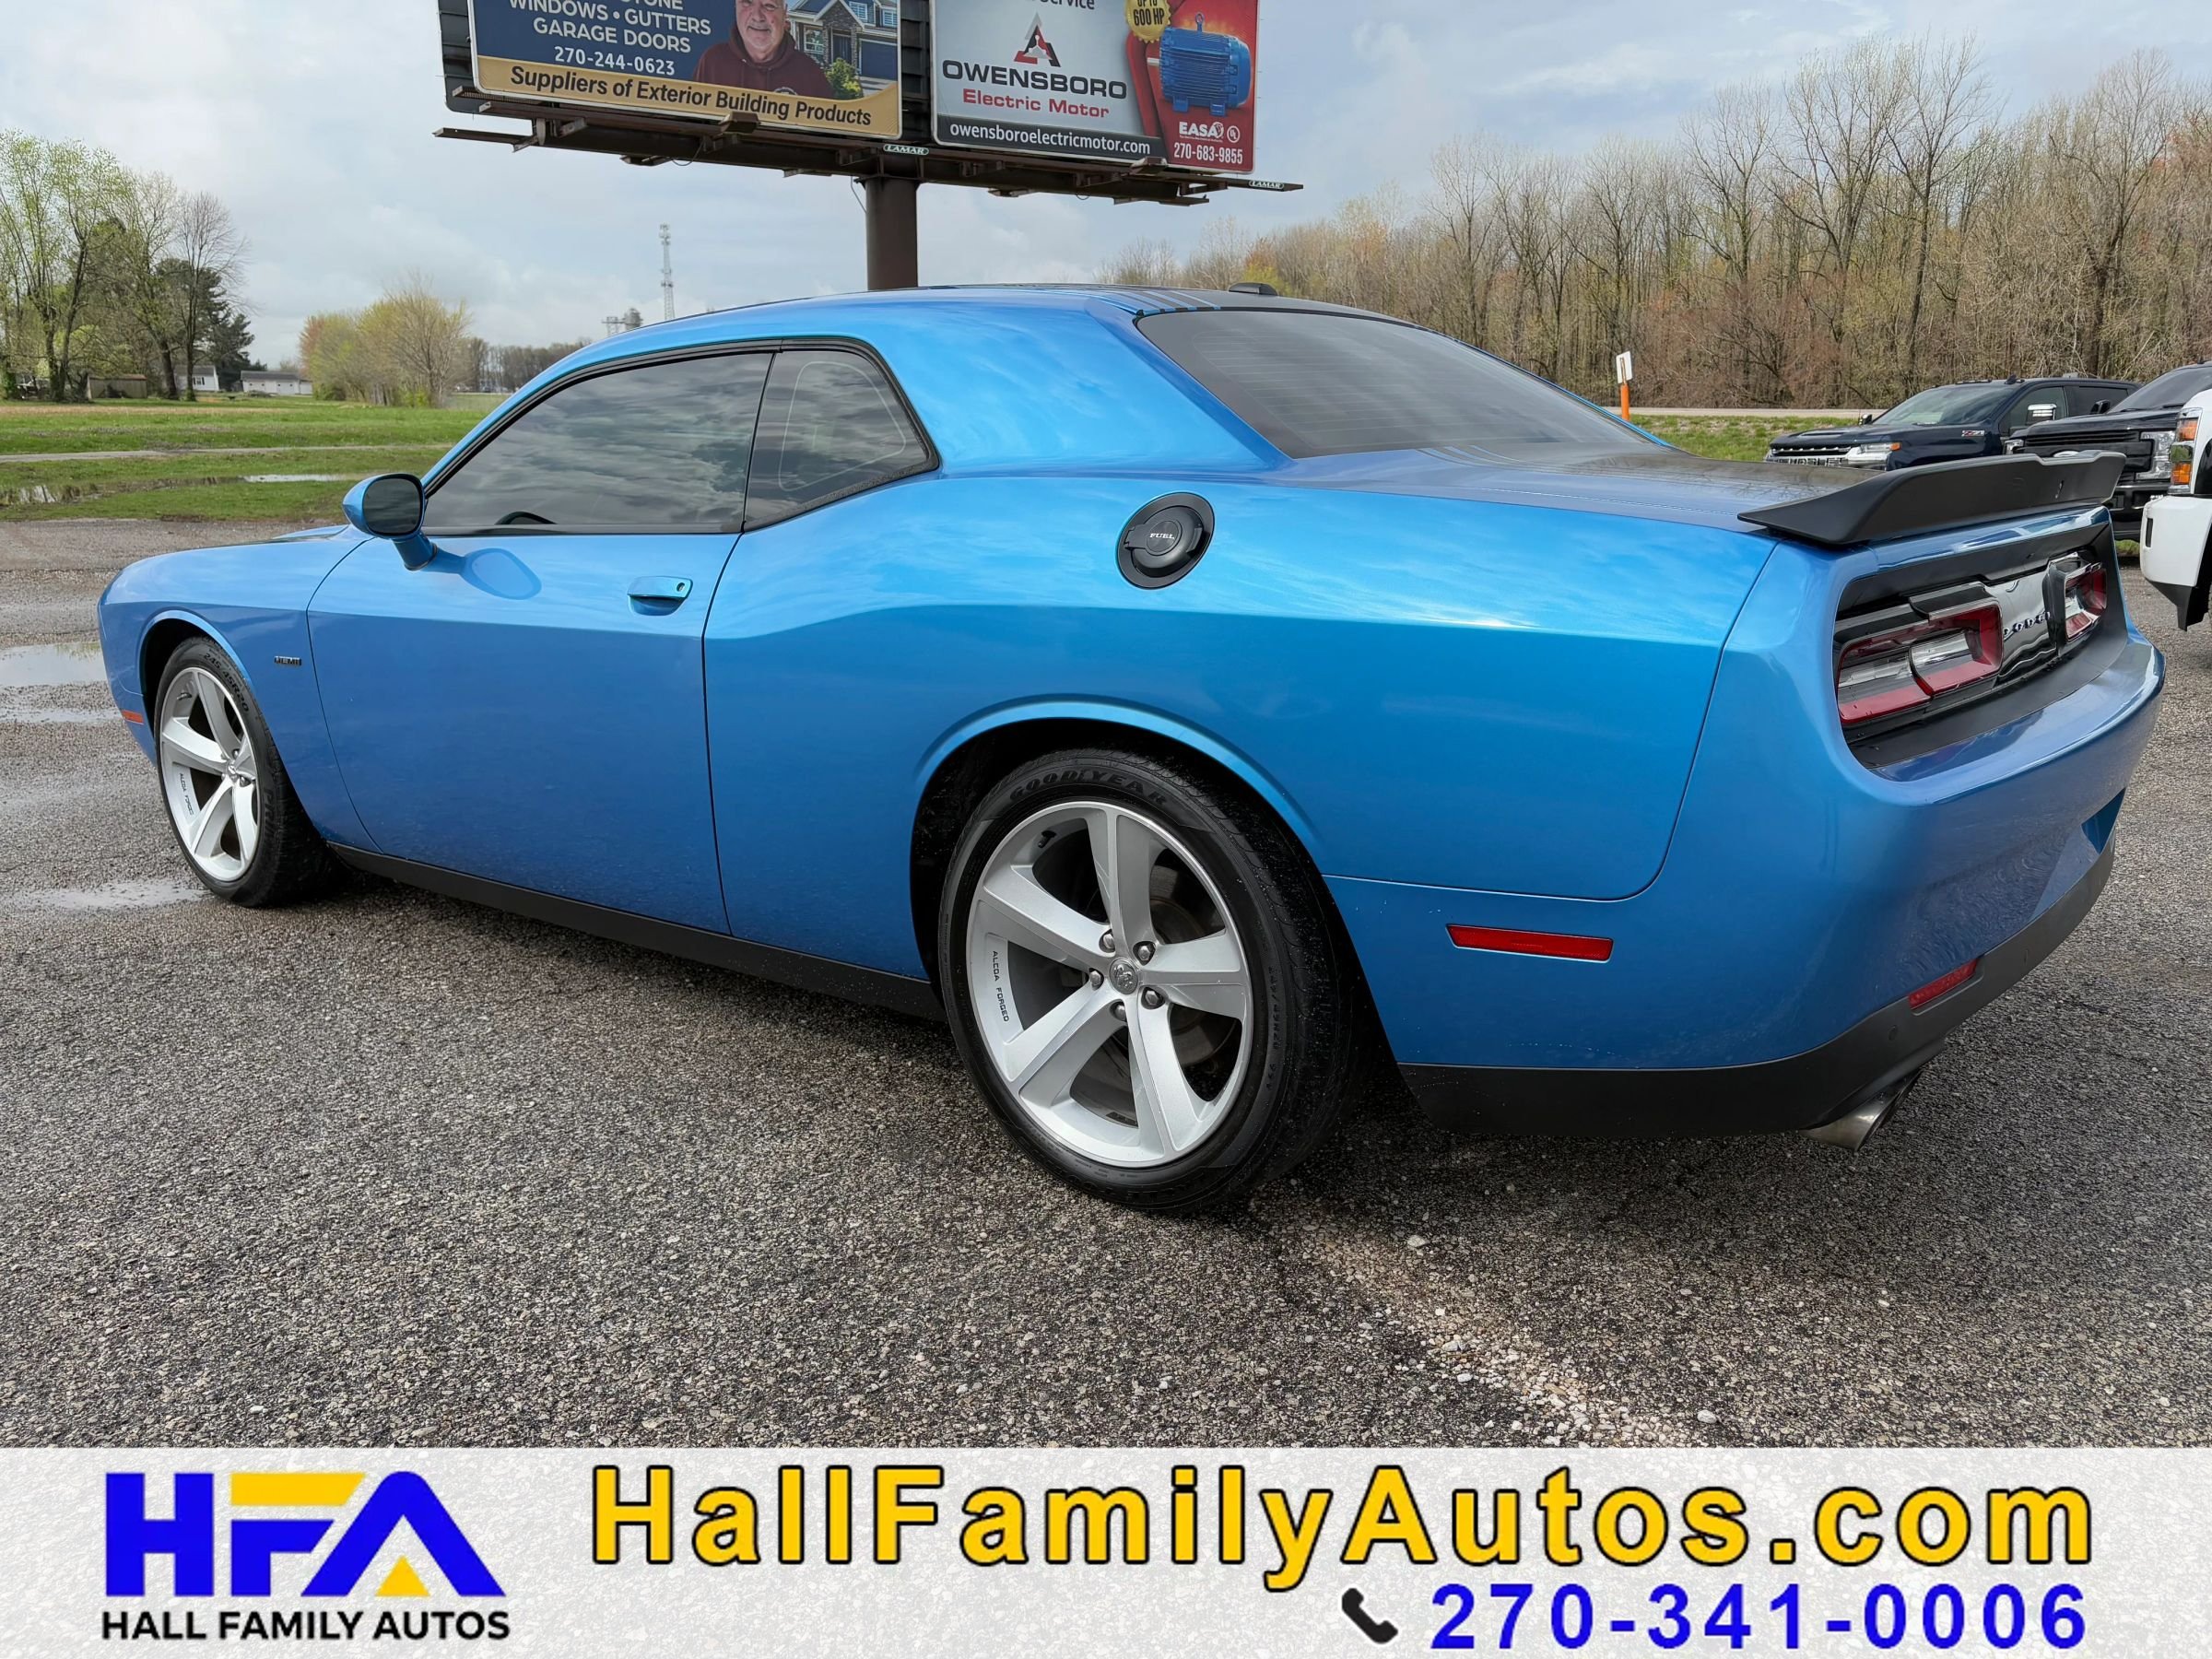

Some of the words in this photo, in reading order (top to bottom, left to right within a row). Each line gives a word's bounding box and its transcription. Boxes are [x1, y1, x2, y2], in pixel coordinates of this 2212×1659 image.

[509, 0, 609, 21] WINDOWS
[624, 8, 712, 35] GUTTERS
[1134, 8, 1152, 26] 600
[1153, 7, 1165, 25] HP
[533, 17, 618, 43] GARAGE
[623, 29, 691, 53] DOORS
[554, 46, 676, 76] 270-244-0623
[511, 65, 608, 95] Suppliers
[612, 79, 633, 98] of
[637, 81, 712, 107] Exterior
[715, 91, 790, 120] Building
[795, 101, 871, 126] Products
[942, 60, 1127, 100] OWENSBORO
[963, 88, 1041, 112] Electric
[1049, 98, 1110, 118] Motor
[950, 123, 1151, 155] owensboroelectricmotor.com
[1179, 121, 1218, 138] EASA
[888, 145, 924, 155] LAMAR
[1174, 142, 1243, 164] 270-683-9855
[1253, 181, 1281, 189] LAMAR
[1009, 768, 1168, 806] GOODYEAR
[995, 986, 1010, 1022] FORGED
